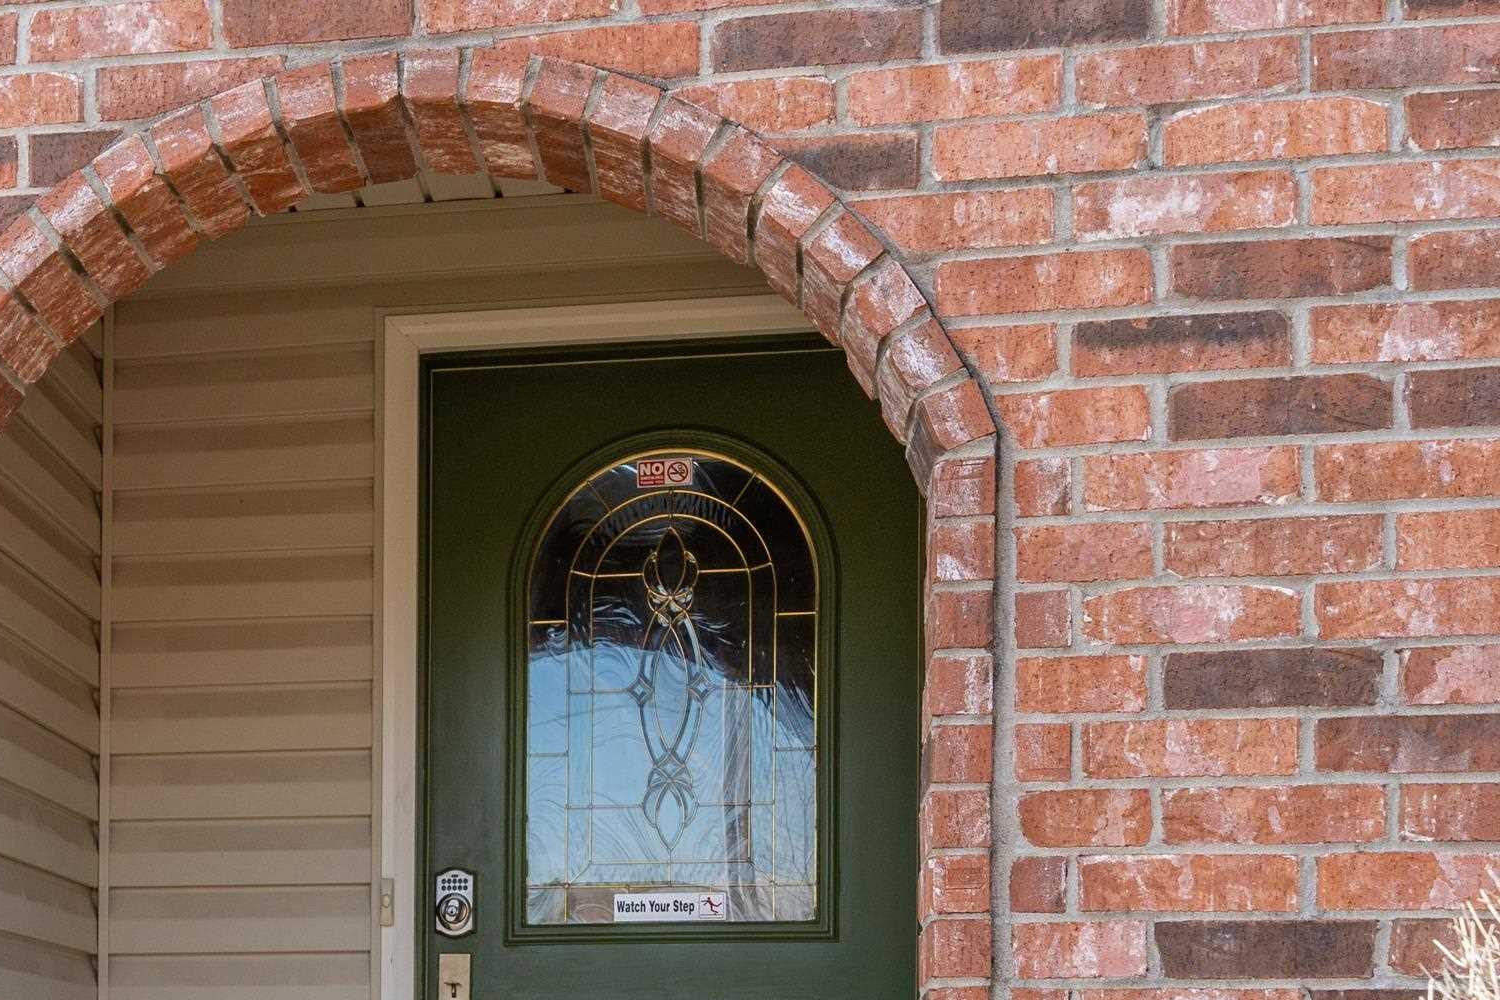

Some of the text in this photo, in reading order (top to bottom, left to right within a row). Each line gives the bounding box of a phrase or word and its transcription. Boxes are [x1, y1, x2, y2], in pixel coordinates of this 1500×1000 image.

[640, 462, 664, 476] NO
[617, 899, 695, 915] Watch Your Step
